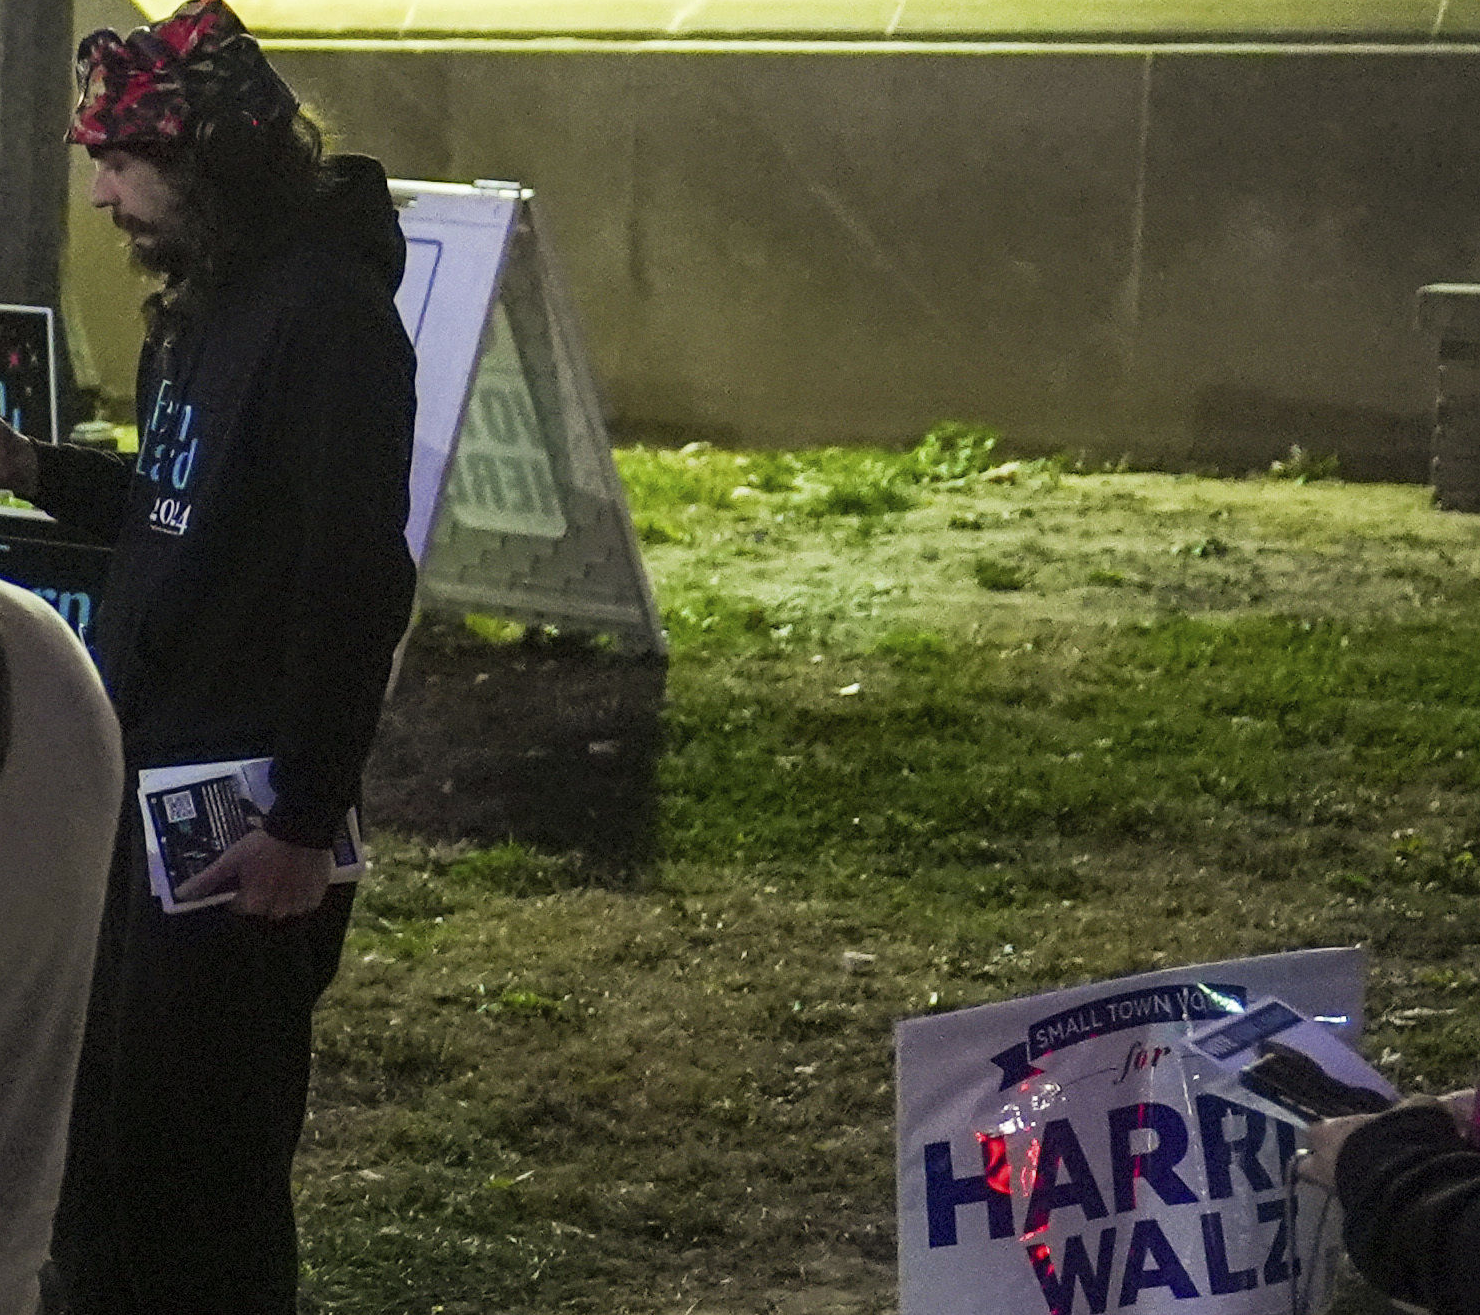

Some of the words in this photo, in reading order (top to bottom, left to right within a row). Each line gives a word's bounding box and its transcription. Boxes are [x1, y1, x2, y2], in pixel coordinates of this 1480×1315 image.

[1034, 1003, 1102, 1049] SMALL
[1105, 990, 1171, 1024] TOWN
[1112, 1043, 1171, 1084] for
[923, 1092, 1298, 1249] HARRI
